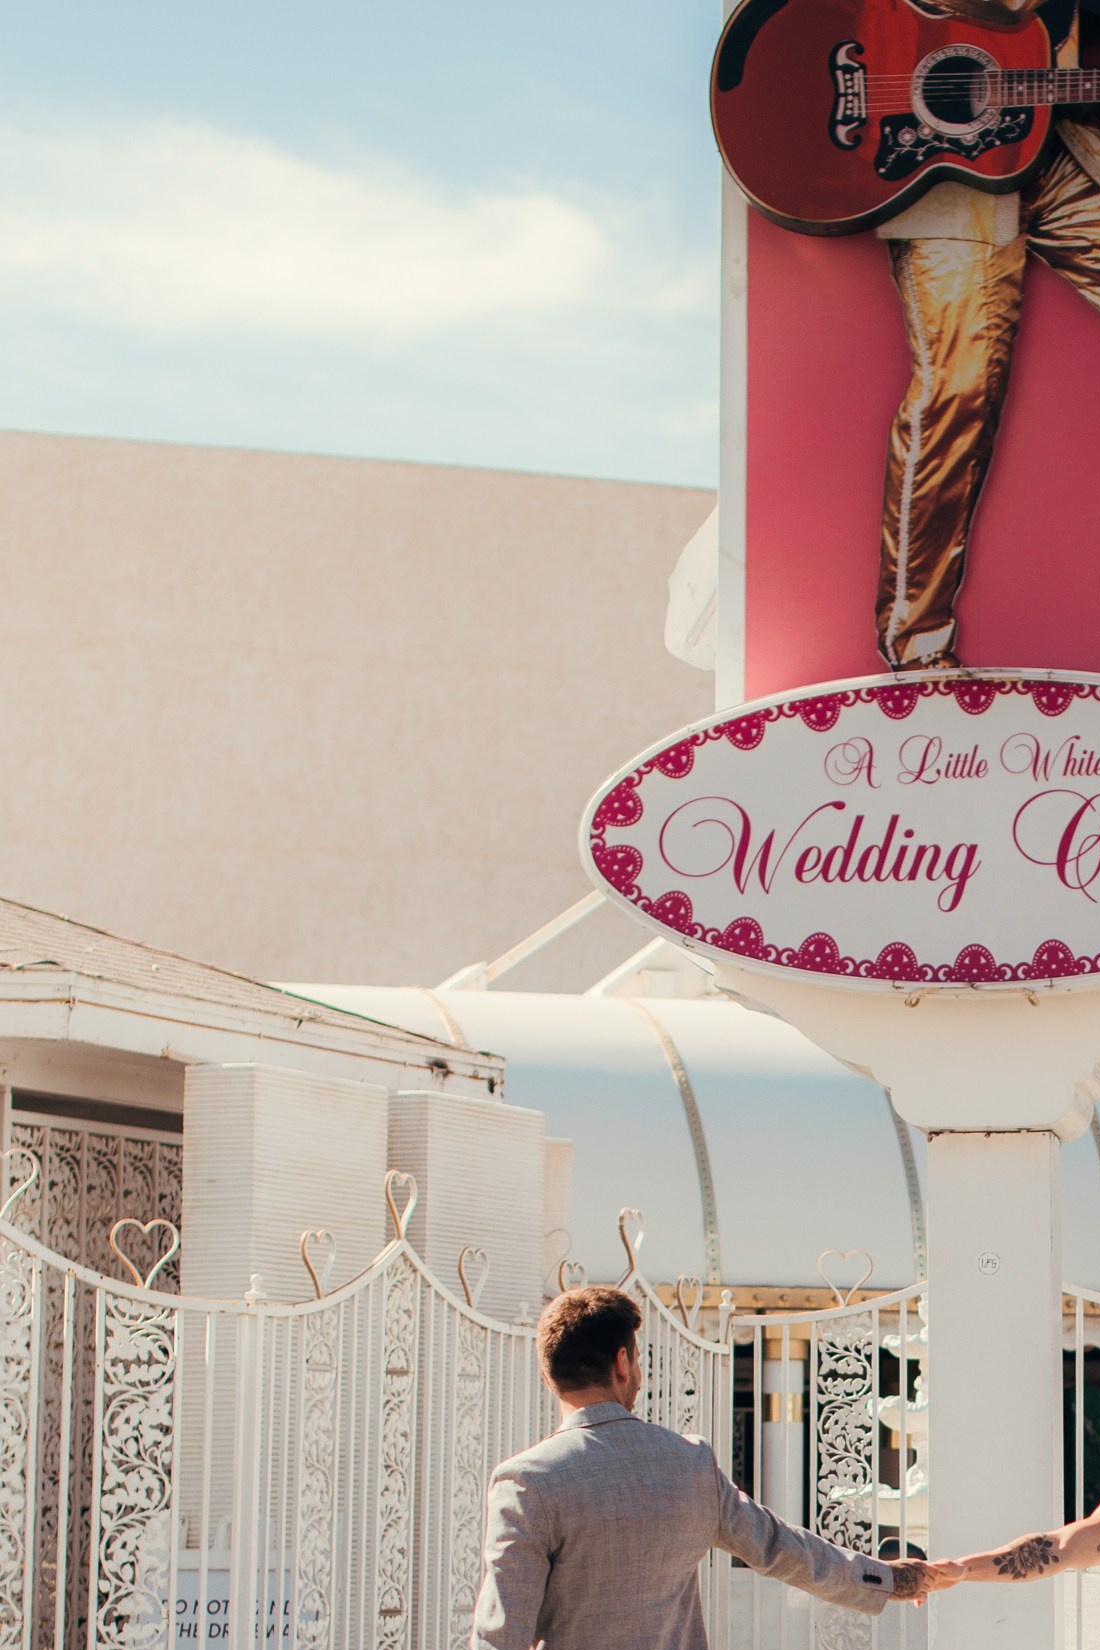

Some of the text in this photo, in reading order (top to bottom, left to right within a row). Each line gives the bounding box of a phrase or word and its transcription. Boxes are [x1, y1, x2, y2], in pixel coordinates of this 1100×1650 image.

[824, 736, 882, 789] A
[897, 735, 989, 784] Little
[659, 796, 982, 912] Wedding
